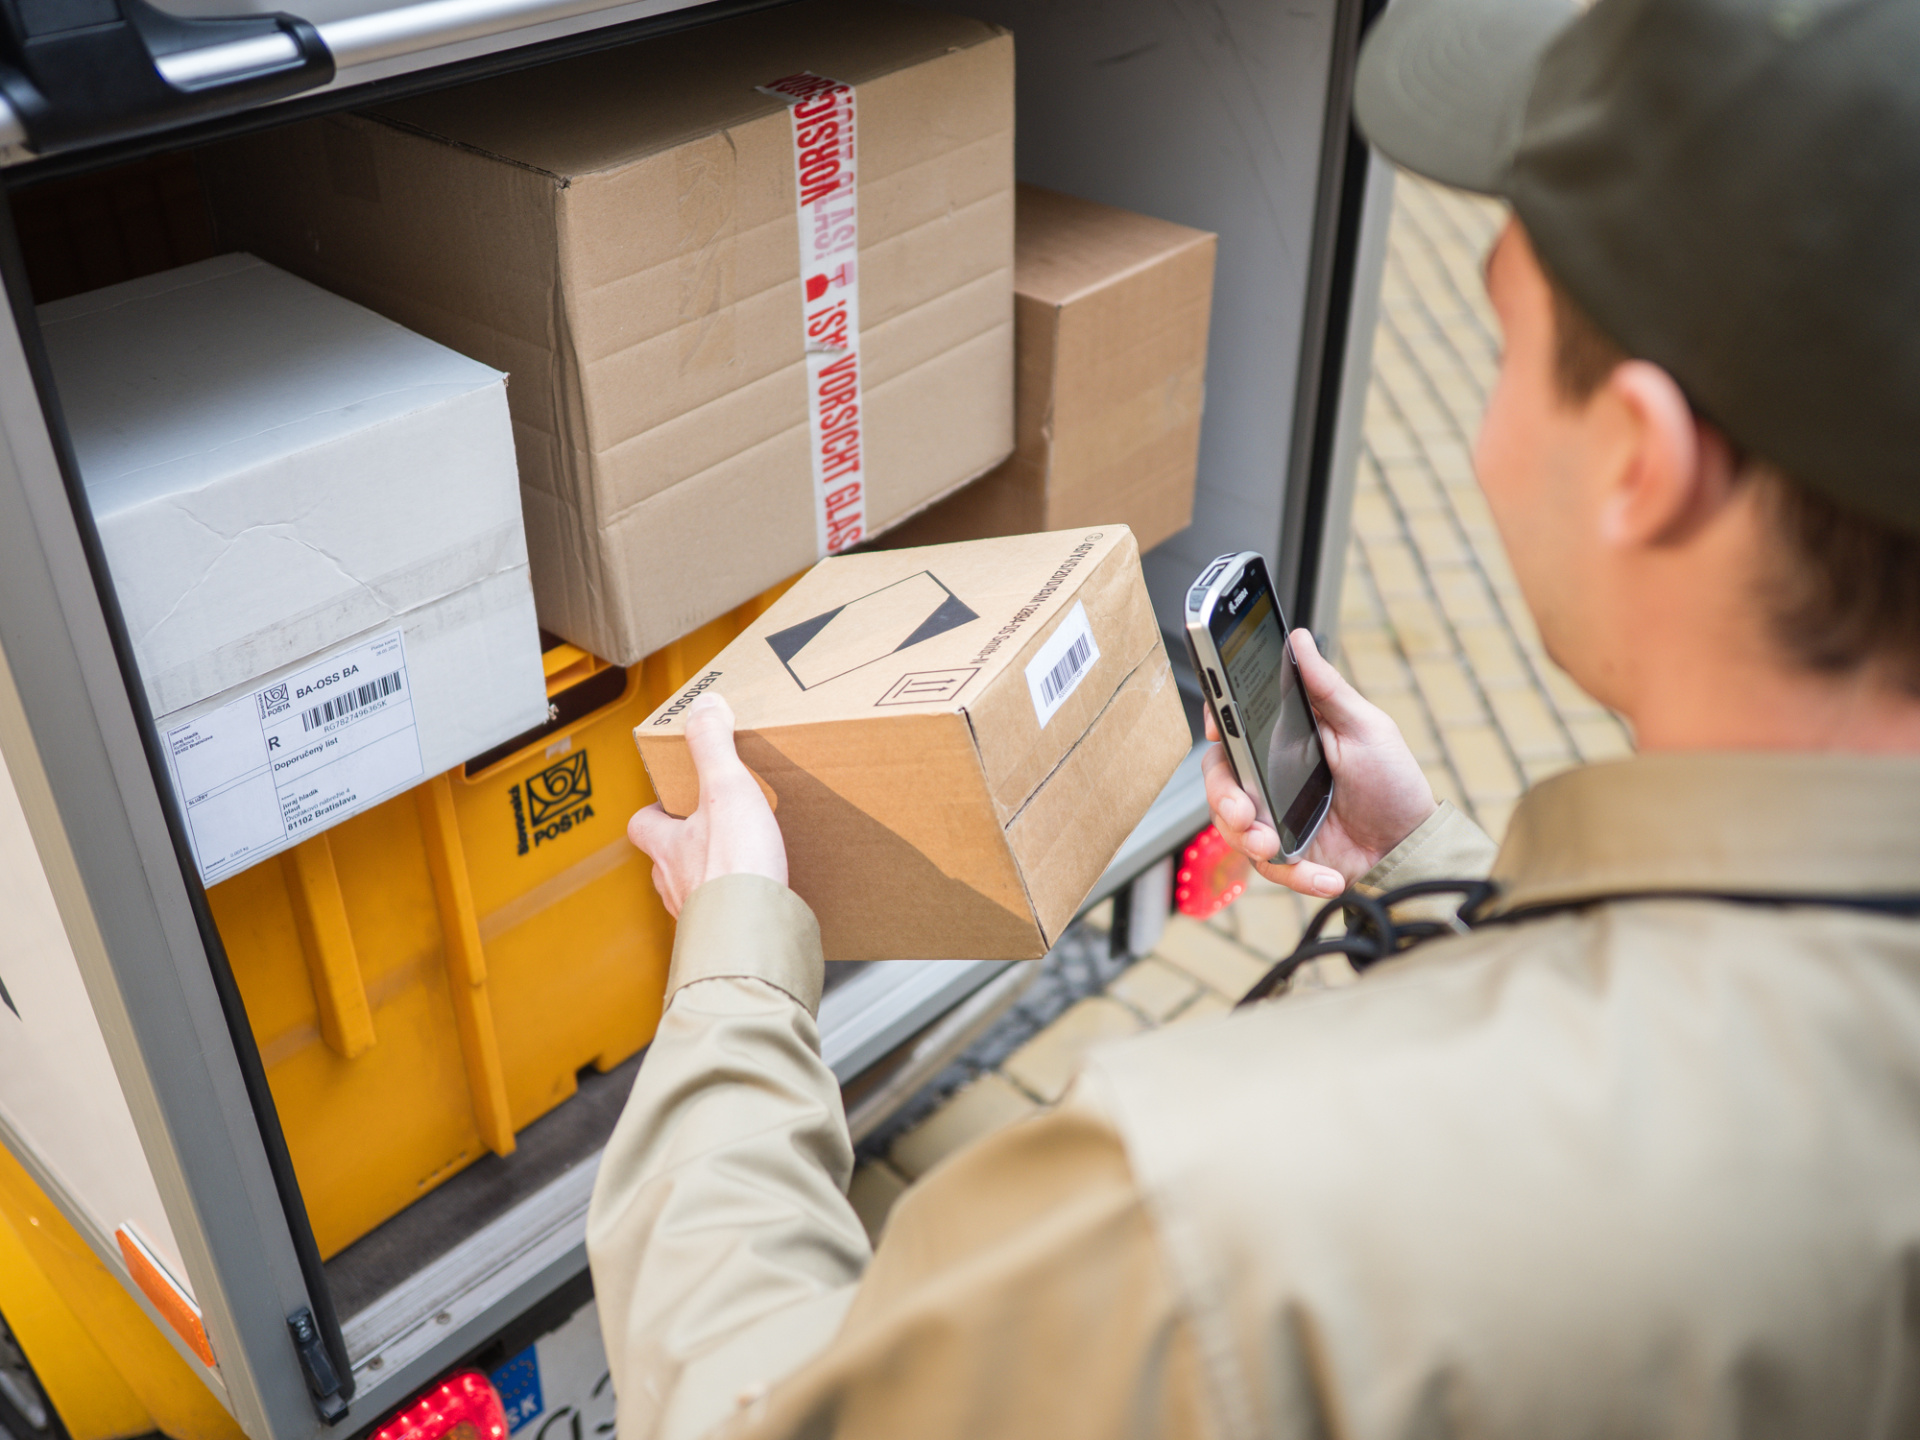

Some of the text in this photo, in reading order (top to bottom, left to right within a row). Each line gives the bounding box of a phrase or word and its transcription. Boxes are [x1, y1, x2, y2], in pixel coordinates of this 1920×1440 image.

[818, 352, 861, 484] VORSICHT
[296, 664, 359, 699] BA-OSS BA
[653, 671, 723, 726] AEROSOLS
[268, 735, 281, 751] R
[274, 737, 338, 772] Doporučený list
[283, 797, 298, 810] juraj
[287, 794, 357, 831] 81102 Bratislava
[534, 803, 595, 848] POŠTA
